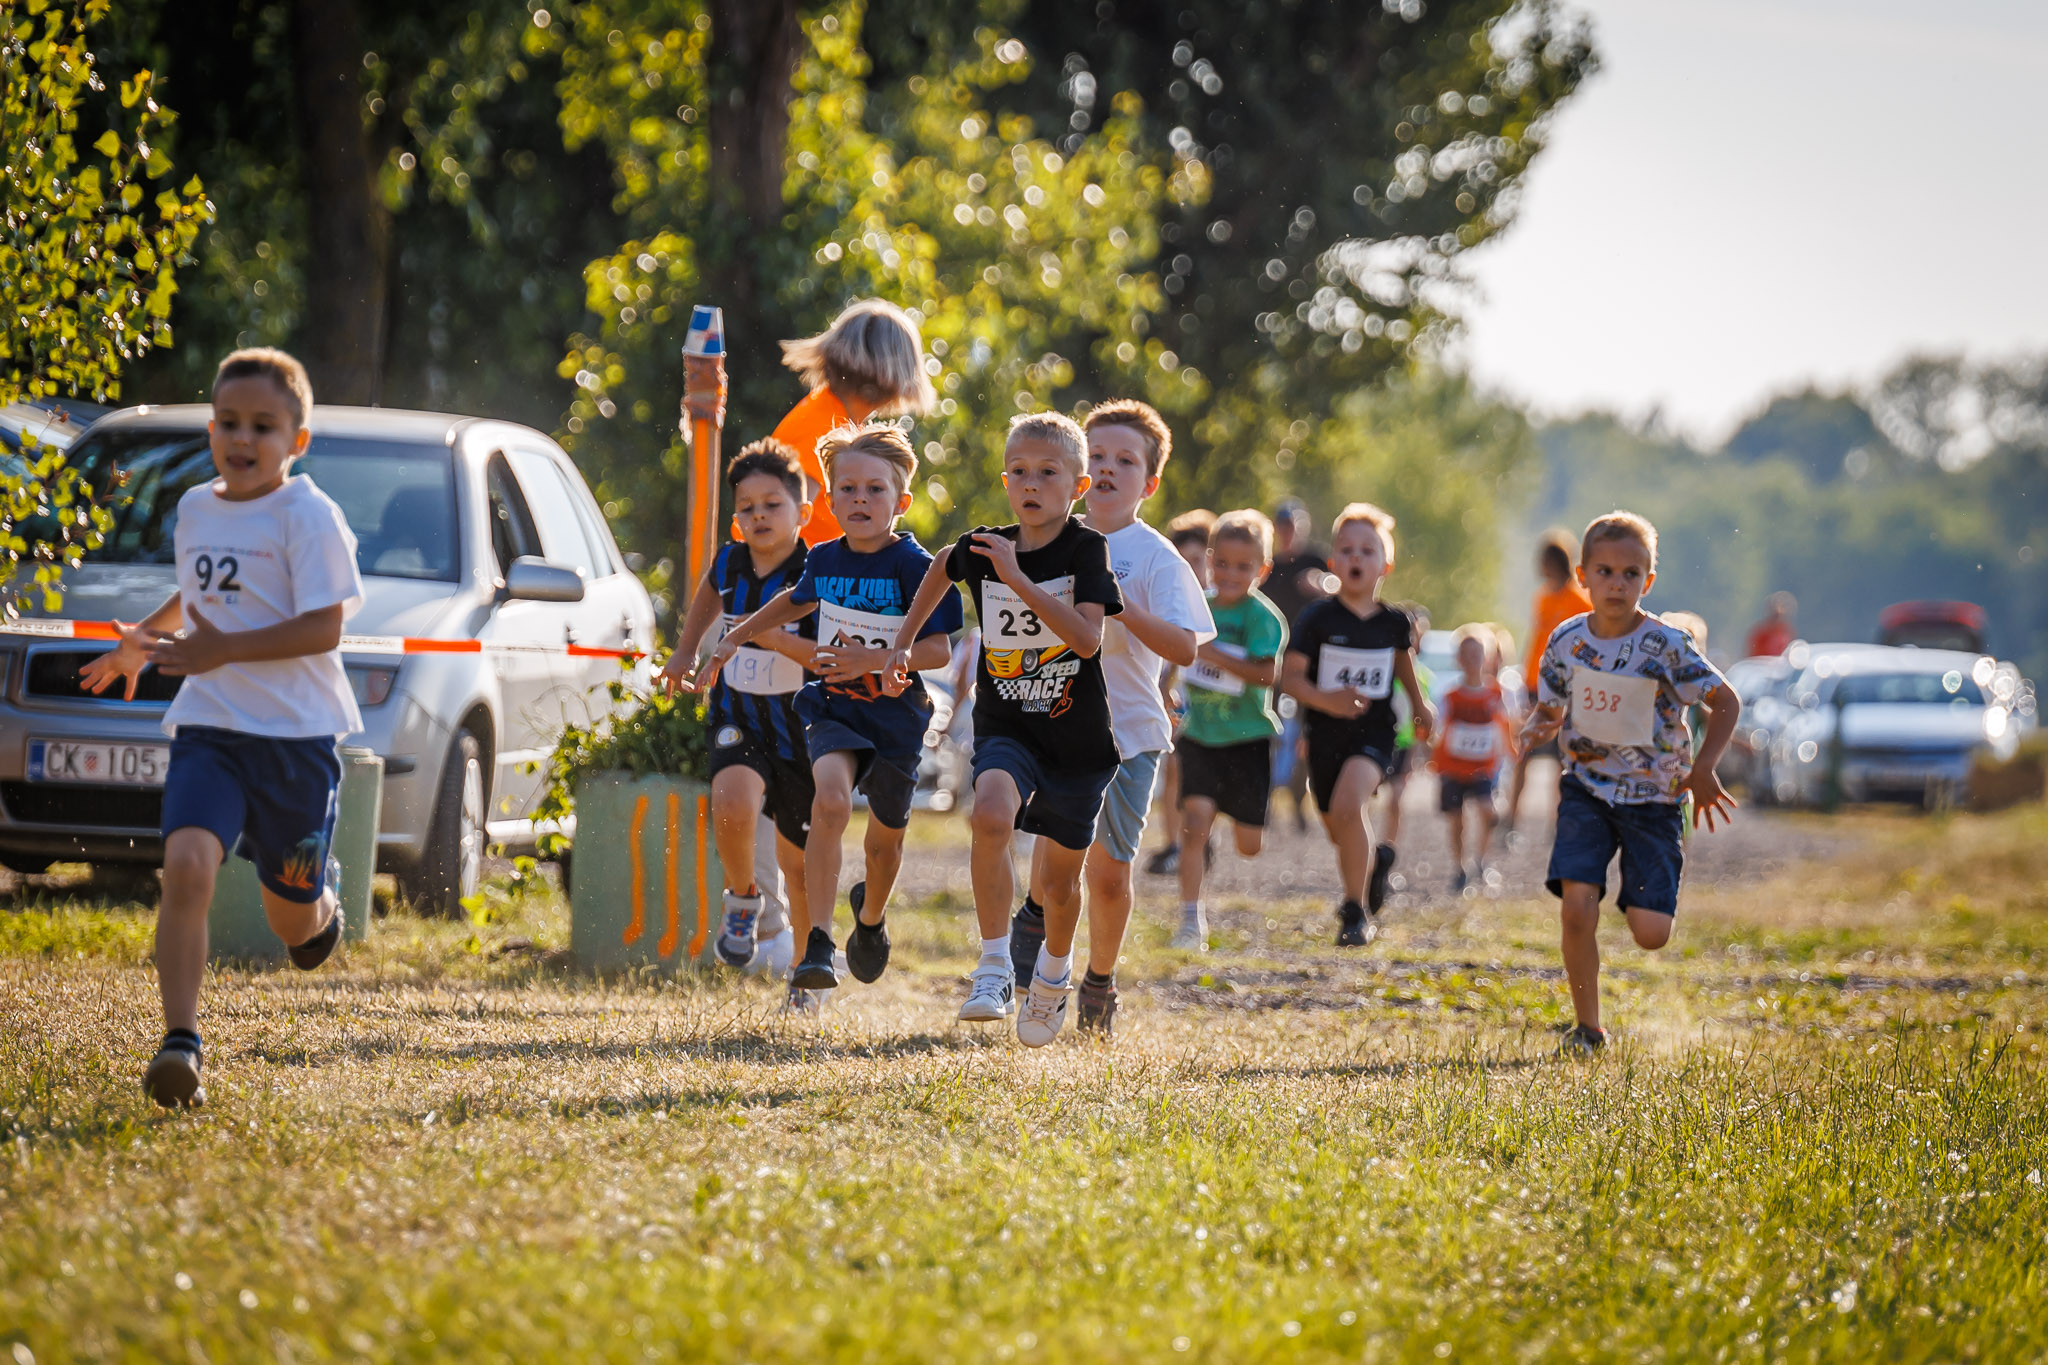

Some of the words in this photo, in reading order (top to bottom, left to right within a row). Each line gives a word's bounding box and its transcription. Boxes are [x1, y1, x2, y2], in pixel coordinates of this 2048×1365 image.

[195, 553, 242, 592] 92
[998, 609, 1042, 637] 23
[731, 655, 775, 687] 191
[1040, 658, 1080, 679] SPEED
[1335, 665, 1382, 689] 448
[1019, 677, 1066, 701] RACE
[1583, 687, 1621, 712] 338
[47, 743, 79, 778] CK
